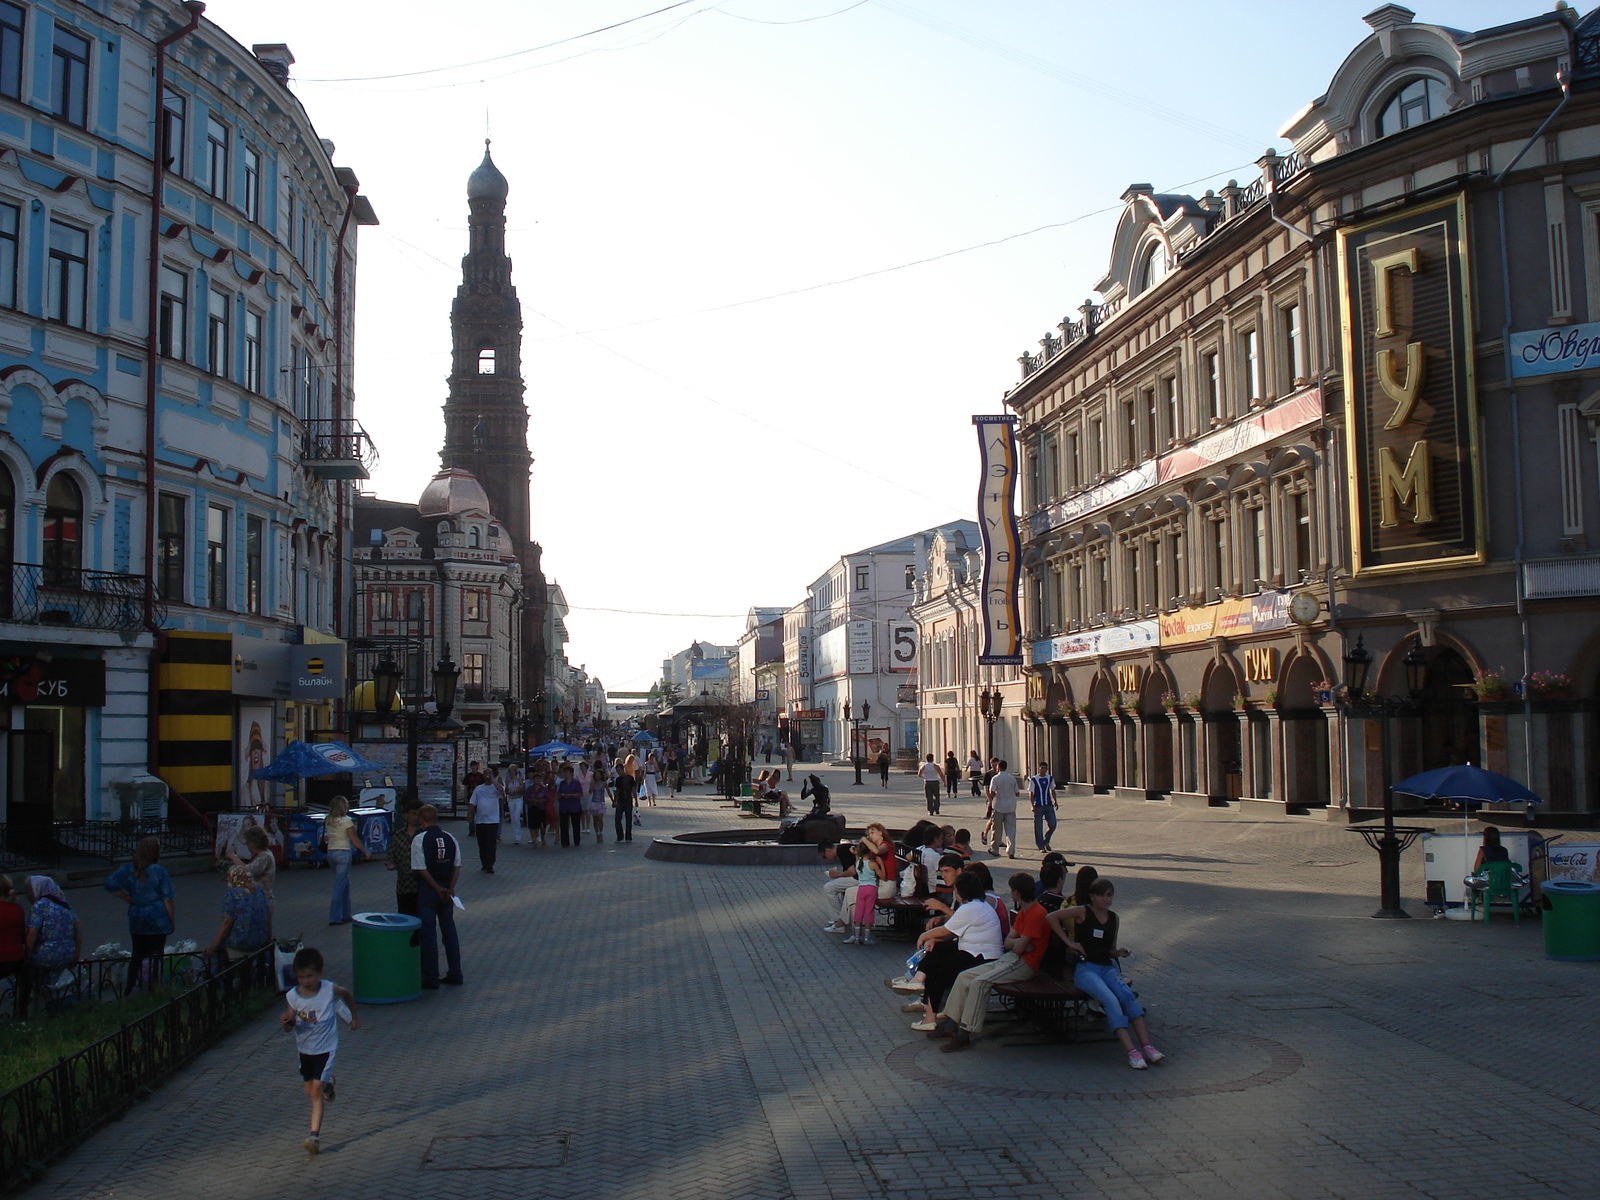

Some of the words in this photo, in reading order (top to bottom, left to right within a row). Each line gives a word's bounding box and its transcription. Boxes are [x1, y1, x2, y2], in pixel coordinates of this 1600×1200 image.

[1523, 329, 1600, 368] Ювел
[1371, 248, 1433, 527] ГУМ
[894, 627, 916, 662] 5
[1161, 617, 1186, 638] Kodak
[1187, 621, 1213, 633] express
[1118, 665, 1136, 692] ГУМ
[1244, 648, 1272, 681] ГУМ
